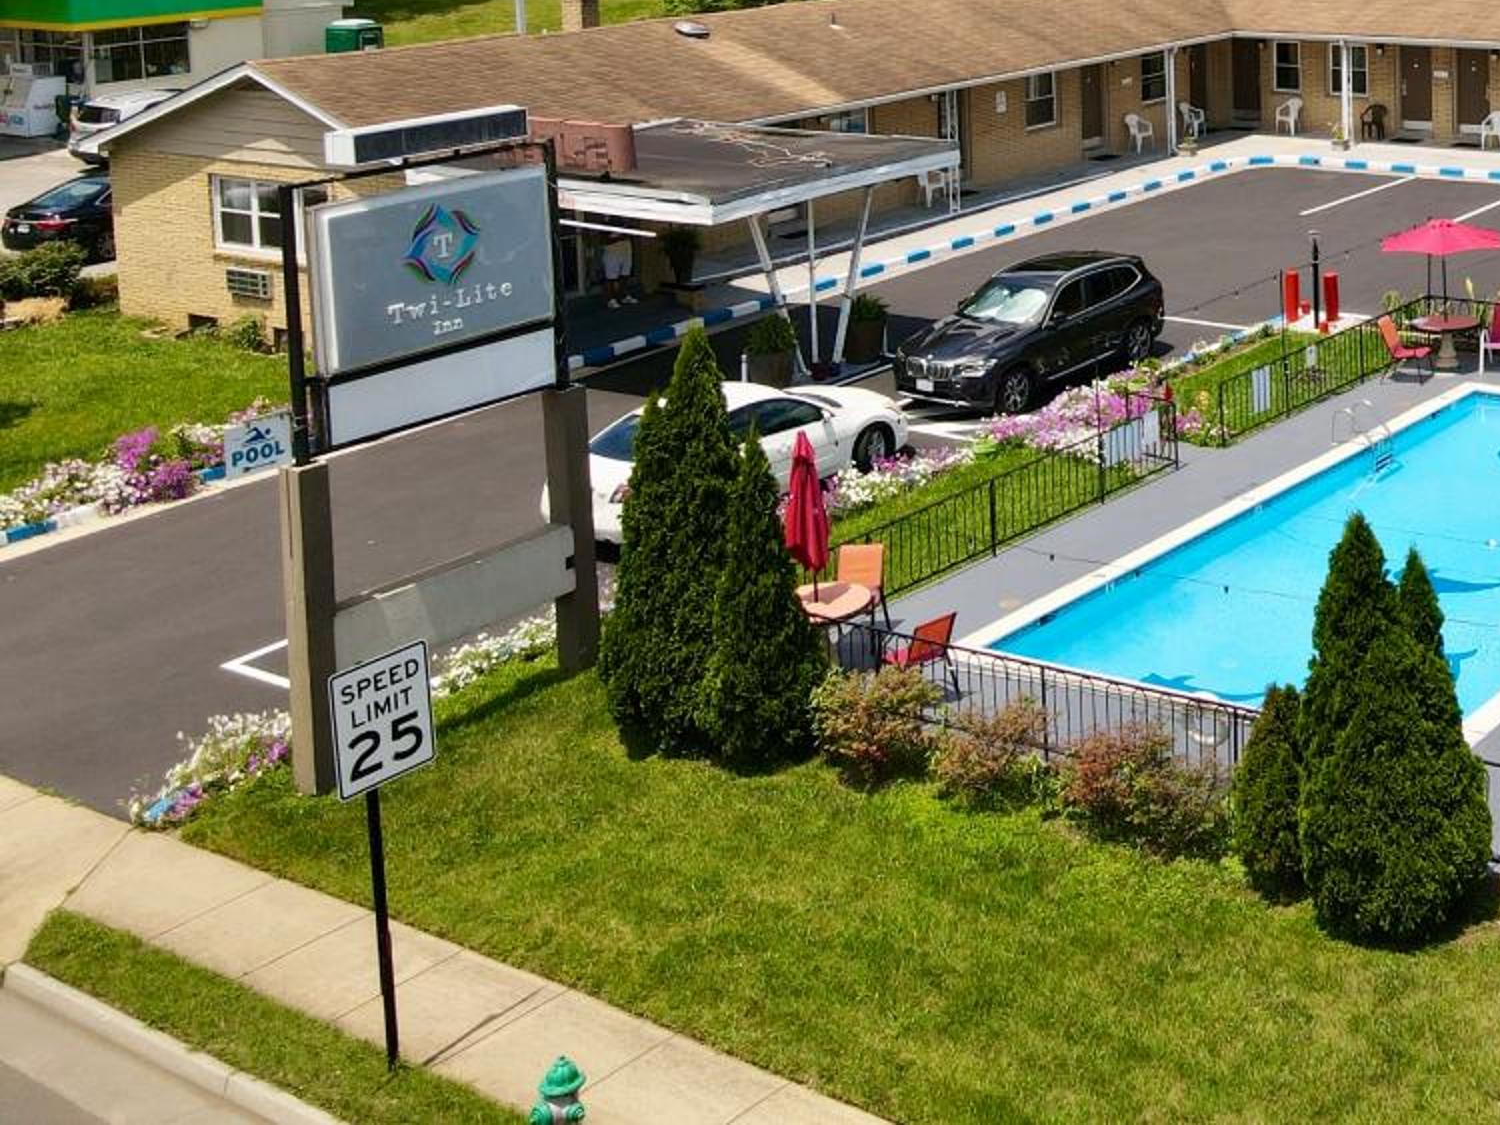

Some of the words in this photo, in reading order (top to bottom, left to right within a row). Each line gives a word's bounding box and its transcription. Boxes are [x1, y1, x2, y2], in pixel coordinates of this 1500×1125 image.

[433, 233, 453, 258] T
[387, 280, 512, 324] Twi-Lite
[433, 317, 463, 335] Inn
[231, 441, 285, 467] POOL
[341, 659, 419, 705] SPEED
[351, 686, 412, 729] LIMIT
[348, 710, 423, 782] 25
